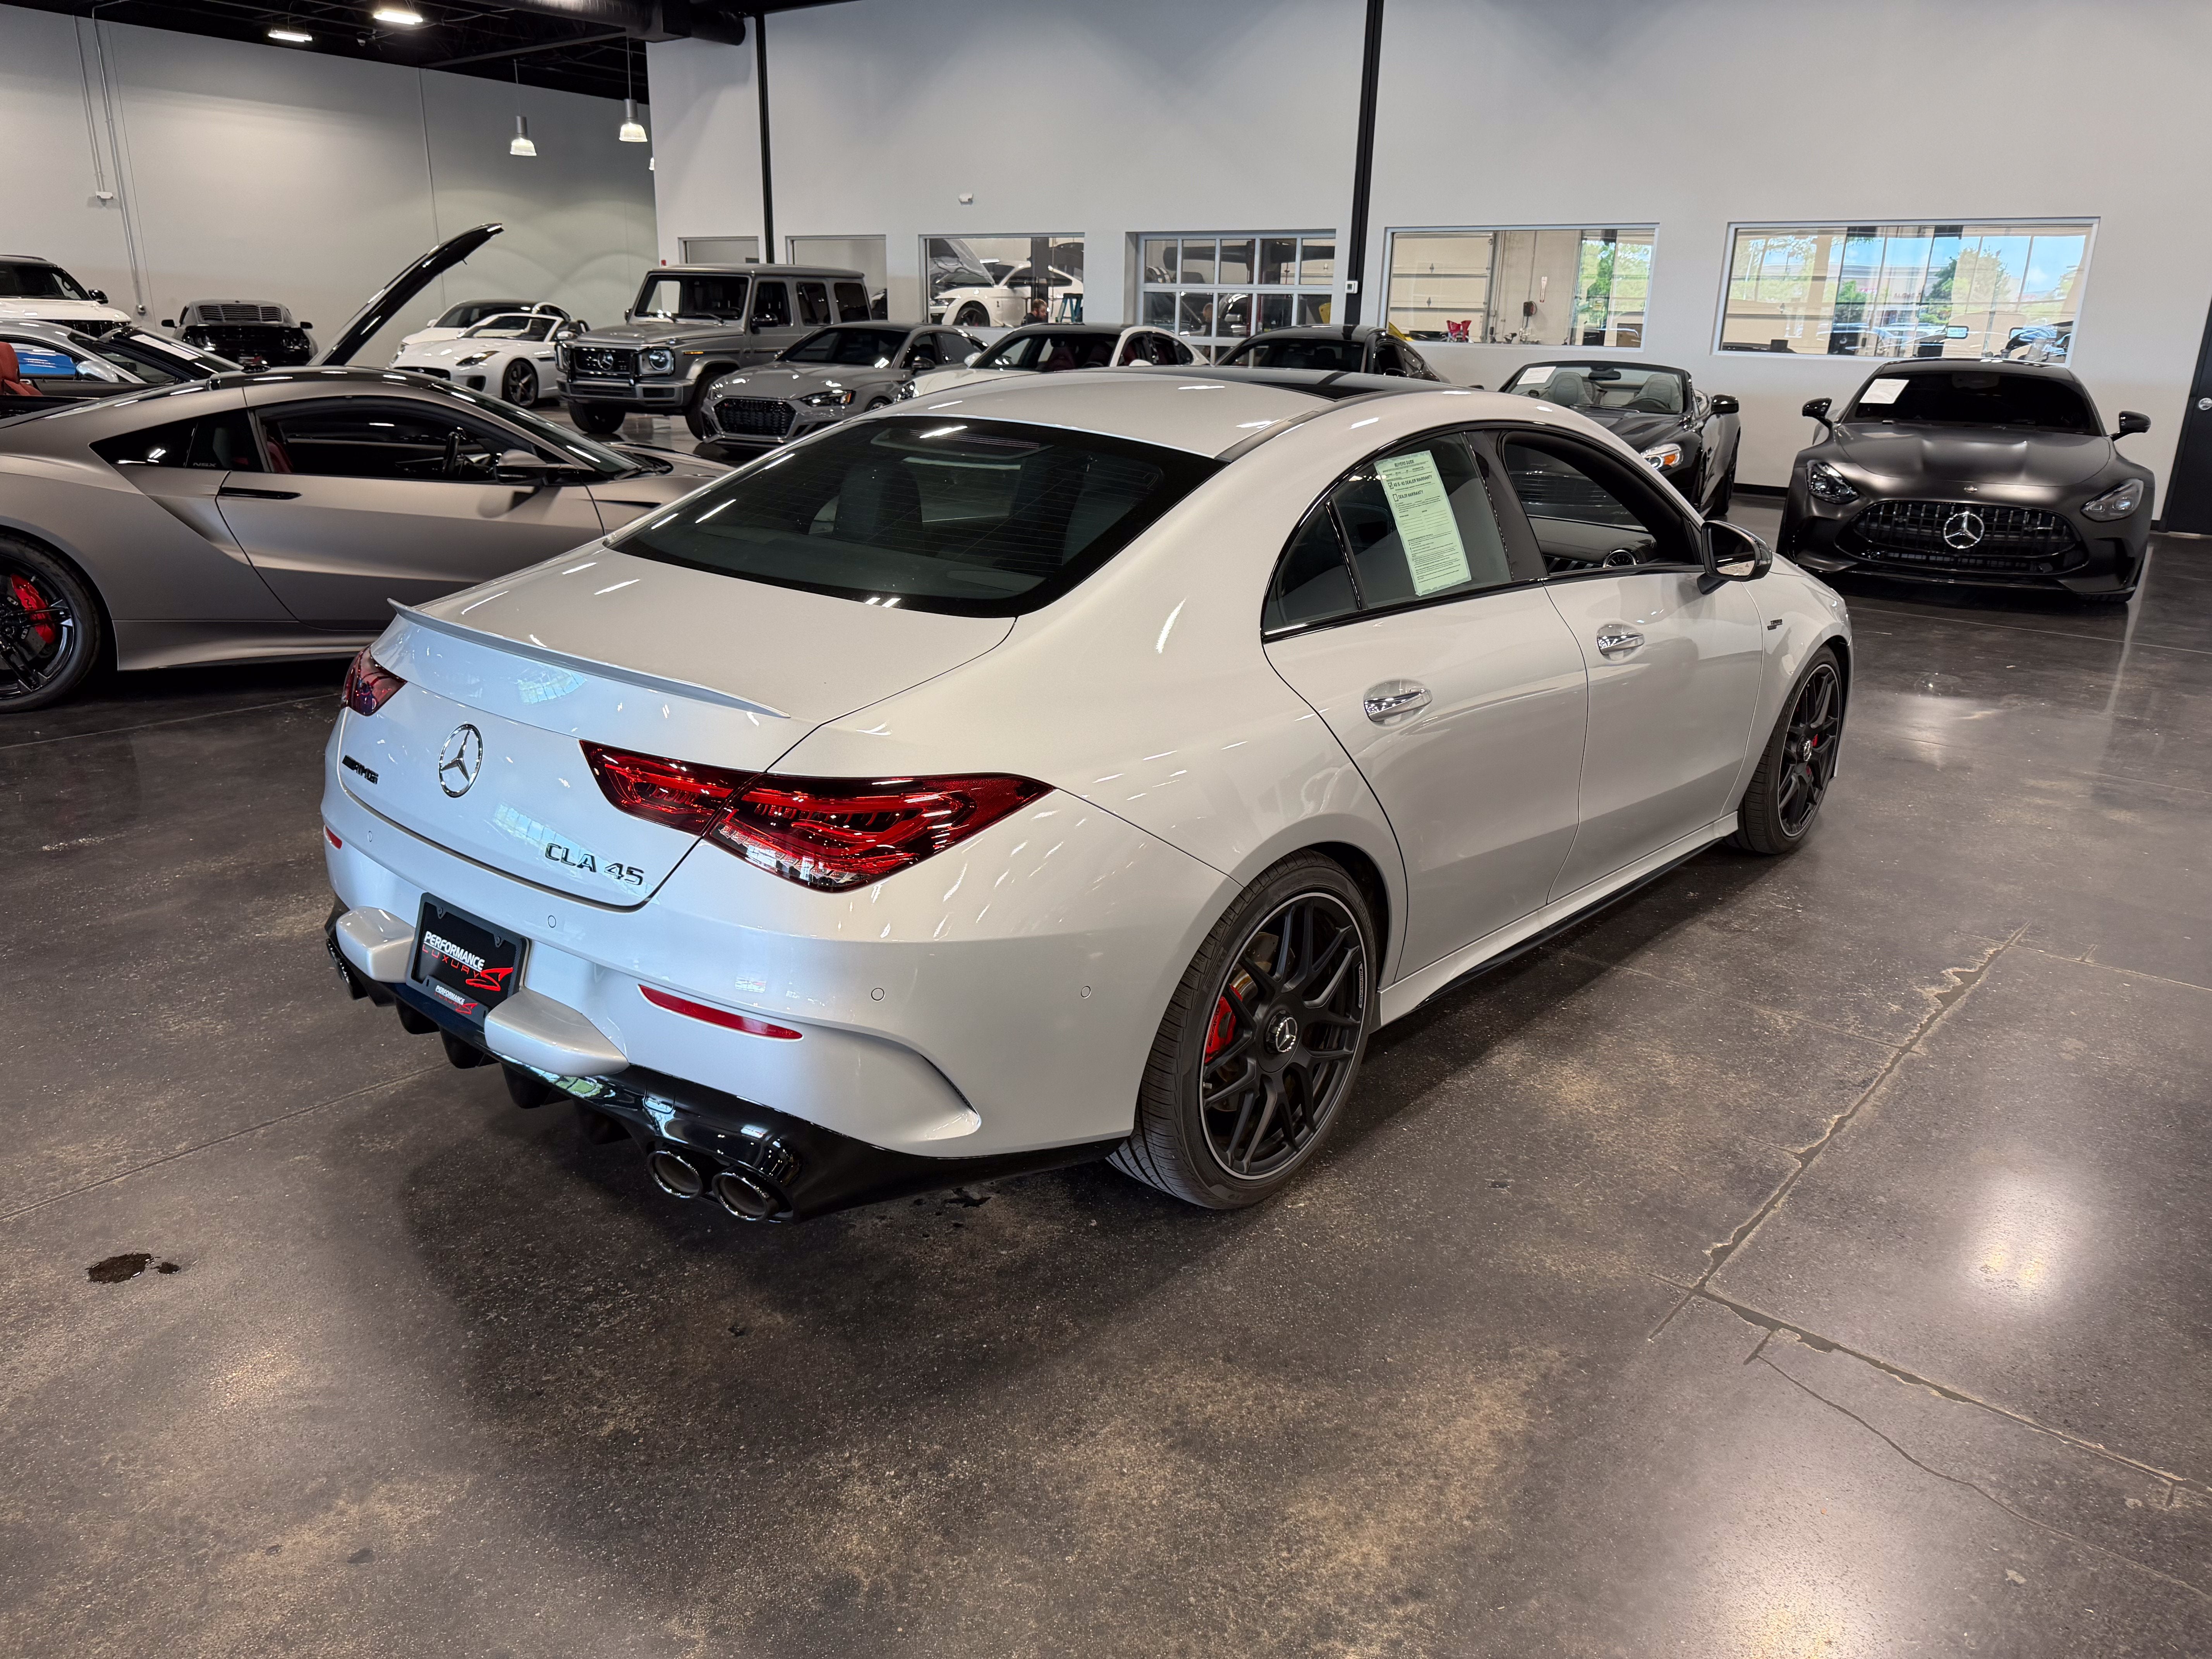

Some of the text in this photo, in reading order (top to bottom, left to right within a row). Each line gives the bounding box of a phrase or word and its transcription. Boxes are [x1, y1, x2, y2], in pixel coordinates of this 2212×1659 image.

[545, 843, 644, 886] CLA 45
[422, 944, 479, 978] LUXURY
[424, 931, 485, 971] PERFORMANCE
[436, 985, 465, 1006] PERFORMANCE
